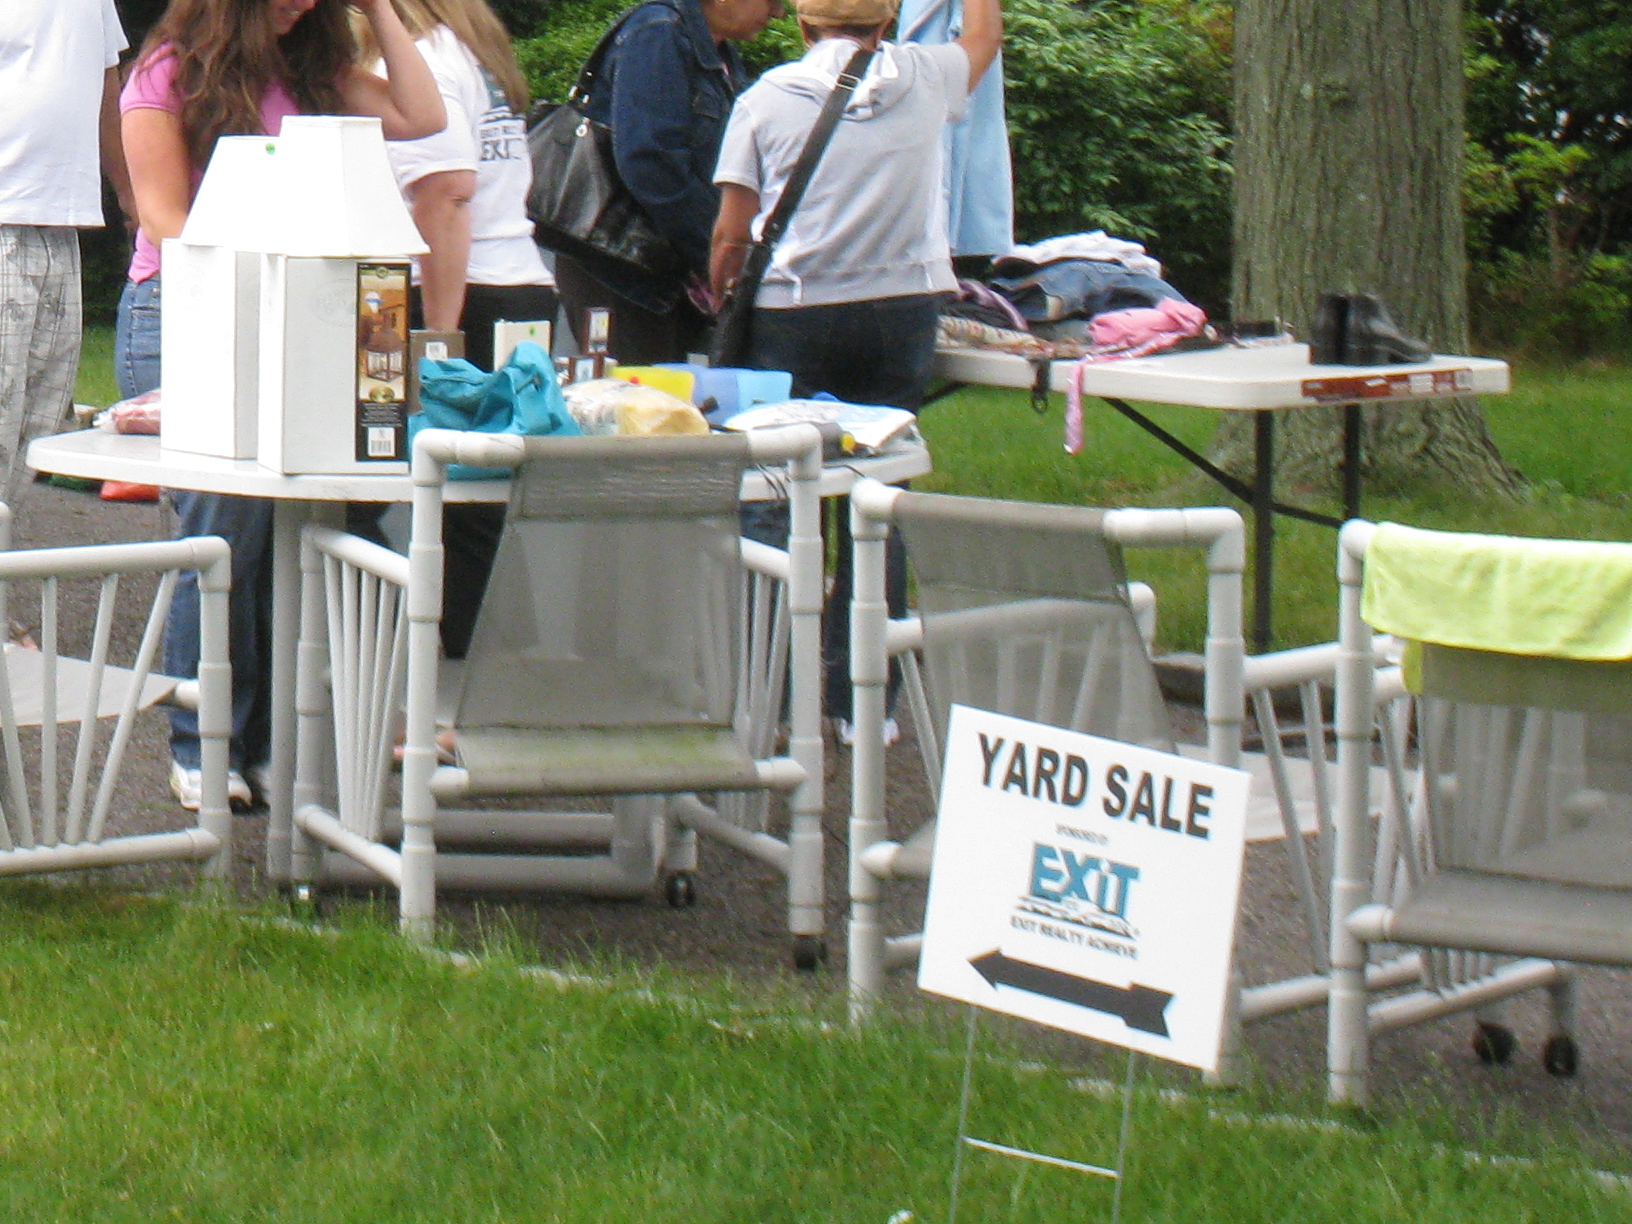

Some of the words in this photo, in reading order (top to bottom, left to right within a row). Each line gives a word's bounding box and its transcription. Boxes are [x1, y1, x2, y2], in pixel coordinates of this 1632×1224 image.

[977, 732, 1090, 809] YARD
[1101, 763, 1215, 841] SALE
[1028, 841, 1141, 919] EXIT
